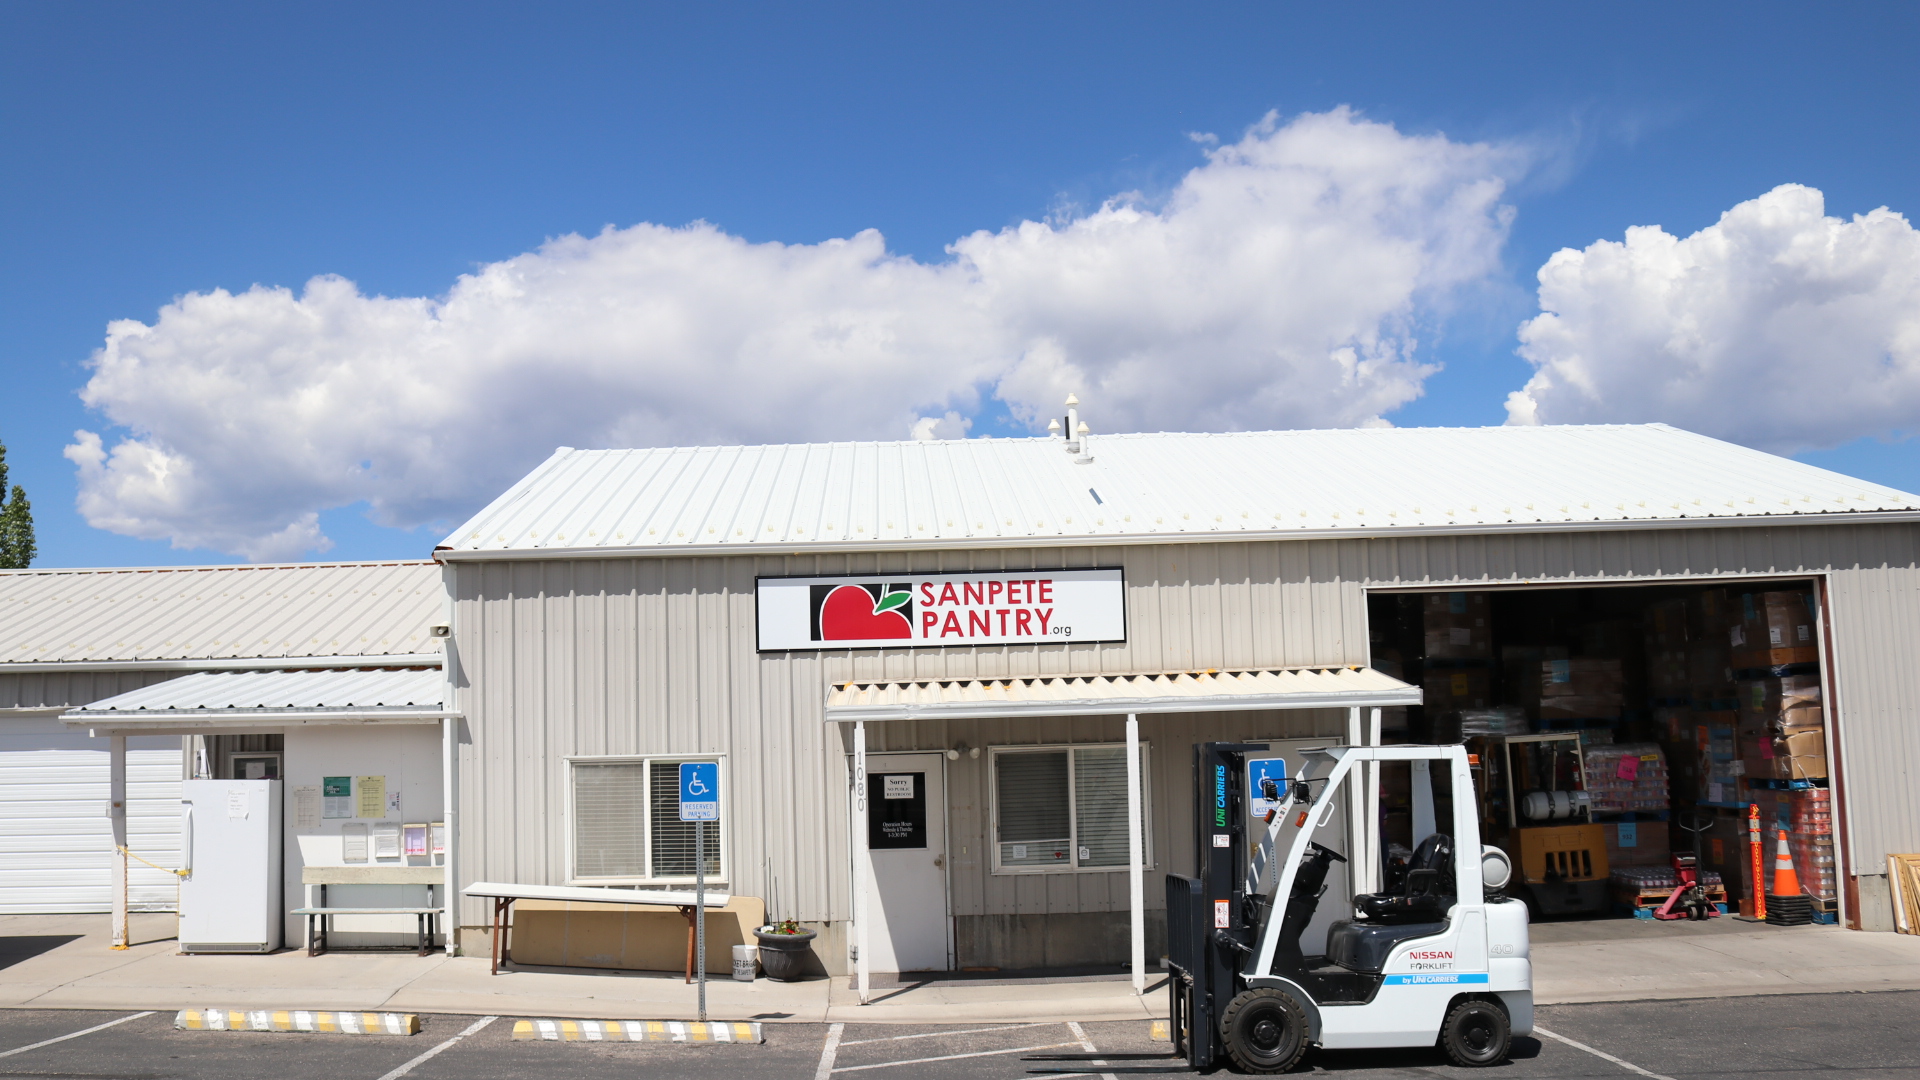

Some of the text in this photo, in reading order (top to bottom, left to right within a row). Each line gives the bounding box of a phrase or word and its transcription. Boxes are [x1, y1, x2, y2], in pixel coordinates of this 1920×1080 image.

[920, 579, 1053, 607] SANPETE
[922, 608, 1072, 638] PANTRY .org
[856, 751, 864, 811] 1080
[1216, 764, 1226, 827] UNICARRIERS
[1410, 951, 1453, 959] NISSAN
[1491, 944, 1513, 954] 40
[1410, 962, 1453, 970] FORKLIFT
[1402, 976, 1411, 984] by
